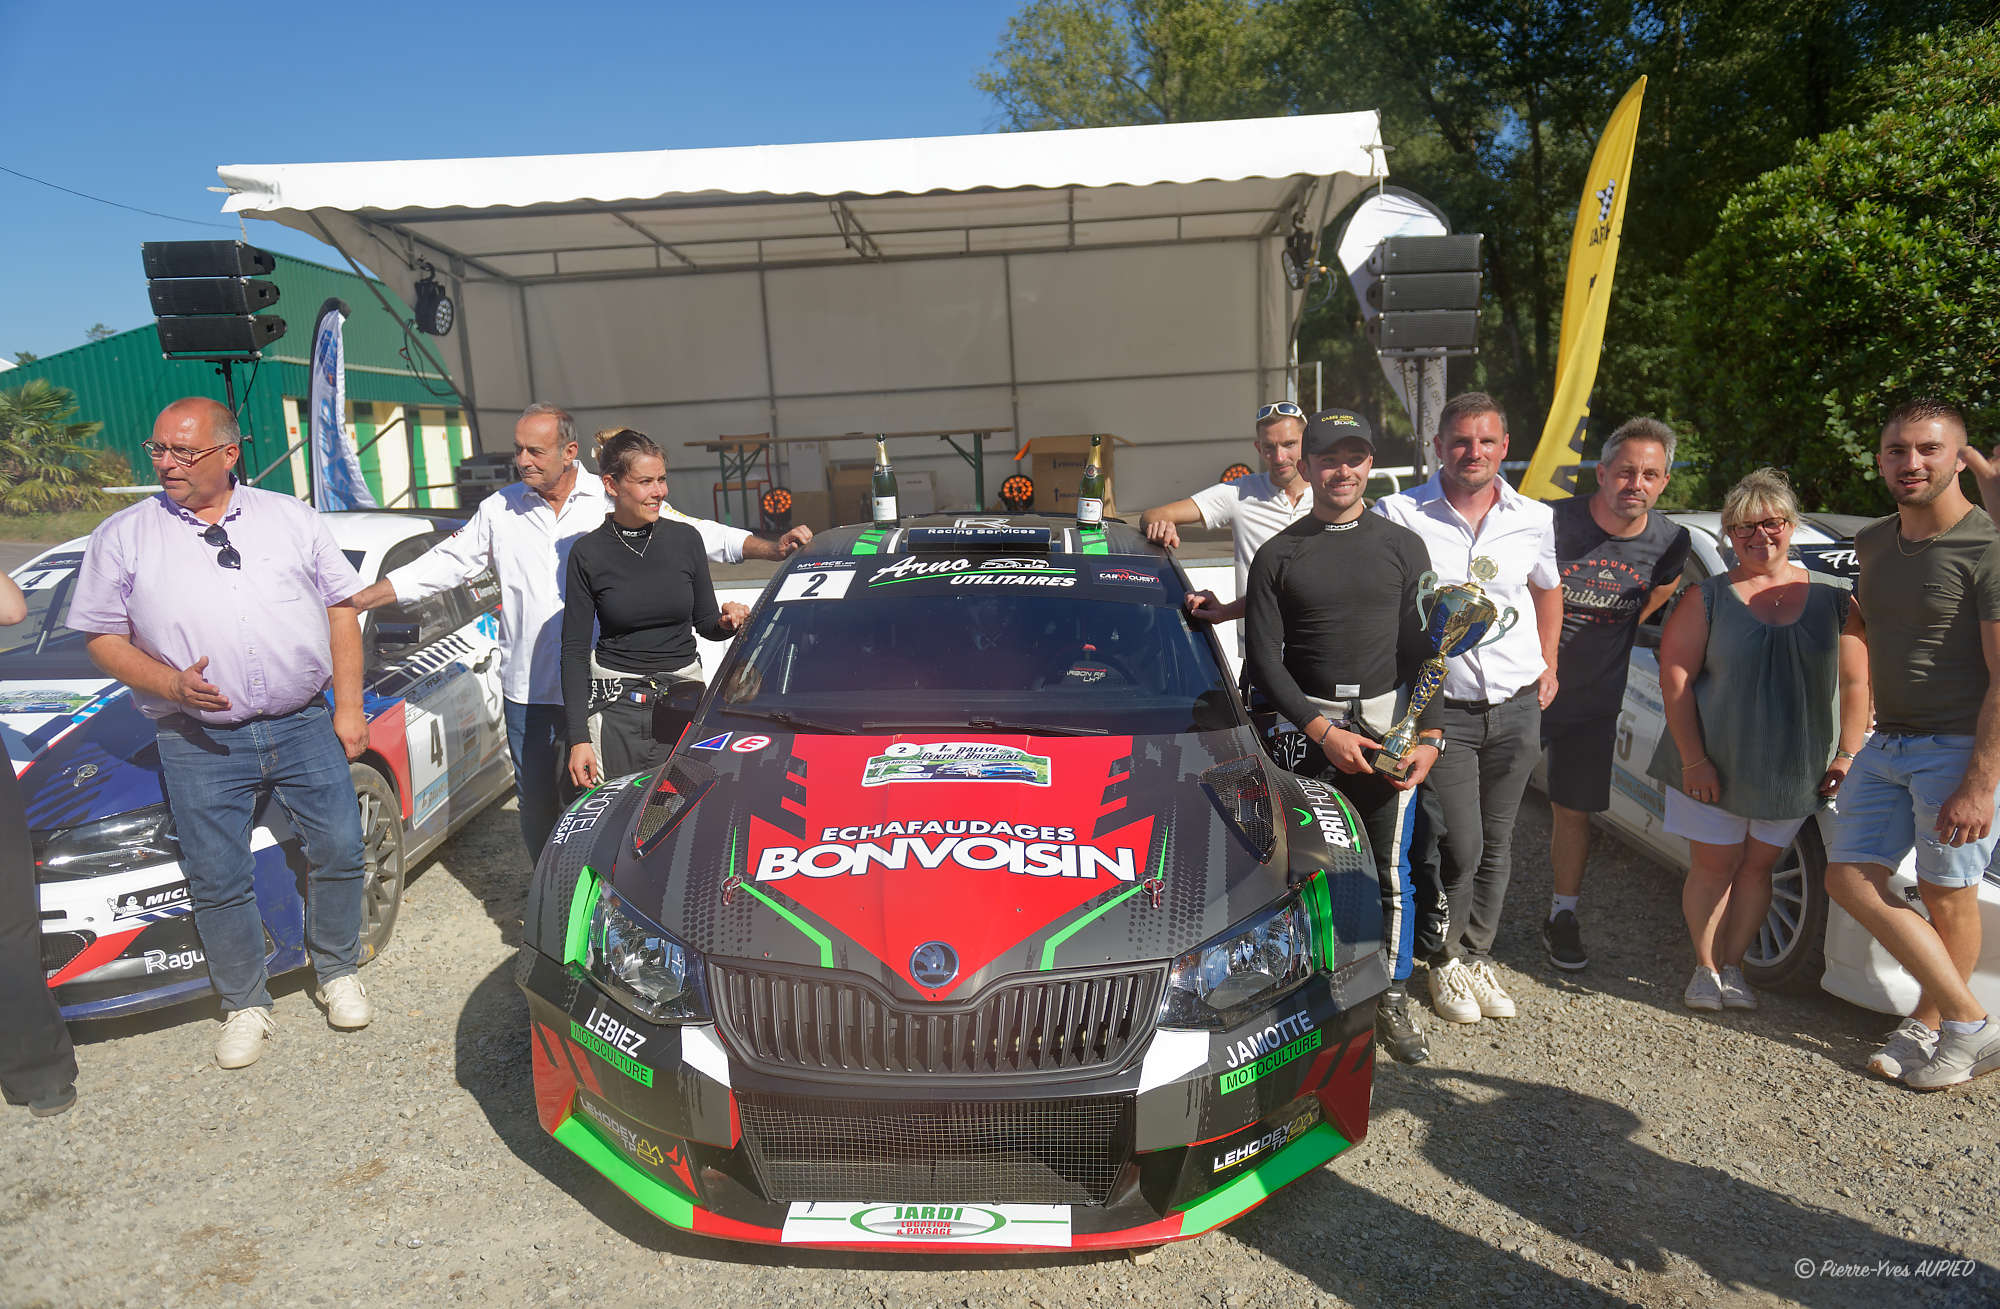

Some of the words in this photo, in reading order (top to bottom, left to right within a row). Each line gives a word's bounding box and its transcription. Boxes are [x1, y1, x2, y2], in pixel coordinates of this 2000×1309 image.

[22, 571, 53, 588] 4
[800, 573, 828, 598] 2
[950, 575, 1077, 588] UTILITAIRES
[430, 717, 444, 768] 4
[736, 738, 767, 750] E
[552, 812, 573, 844] LESSAY
[564, 790, 620, 844] HOTEL
[822, 820, 1076, 842] ECHAFAUDAGES
[1312, 806, 1350, 849] BRIT
[754, 836, 1136, 881] BONVOISIN
[573, 1024, 649, 1083] MOTOCULTURE
[584, 1007, 647, 1058] LEBIEZ
[1226, 1009, 1314, 1068] JAMOTTE
[1226, 1034, 1319, 1090] MOTOCULTURE
[579, 1095, 638, 1142] LEHODEY
[1213, 1120, 1293, 1170] LEHODEY
[1271, 1135, 1288, 1151] TP
[894, 1206, 964, 1220] JARDI
[907, 1227, 952, 1236] PAYSAGE
